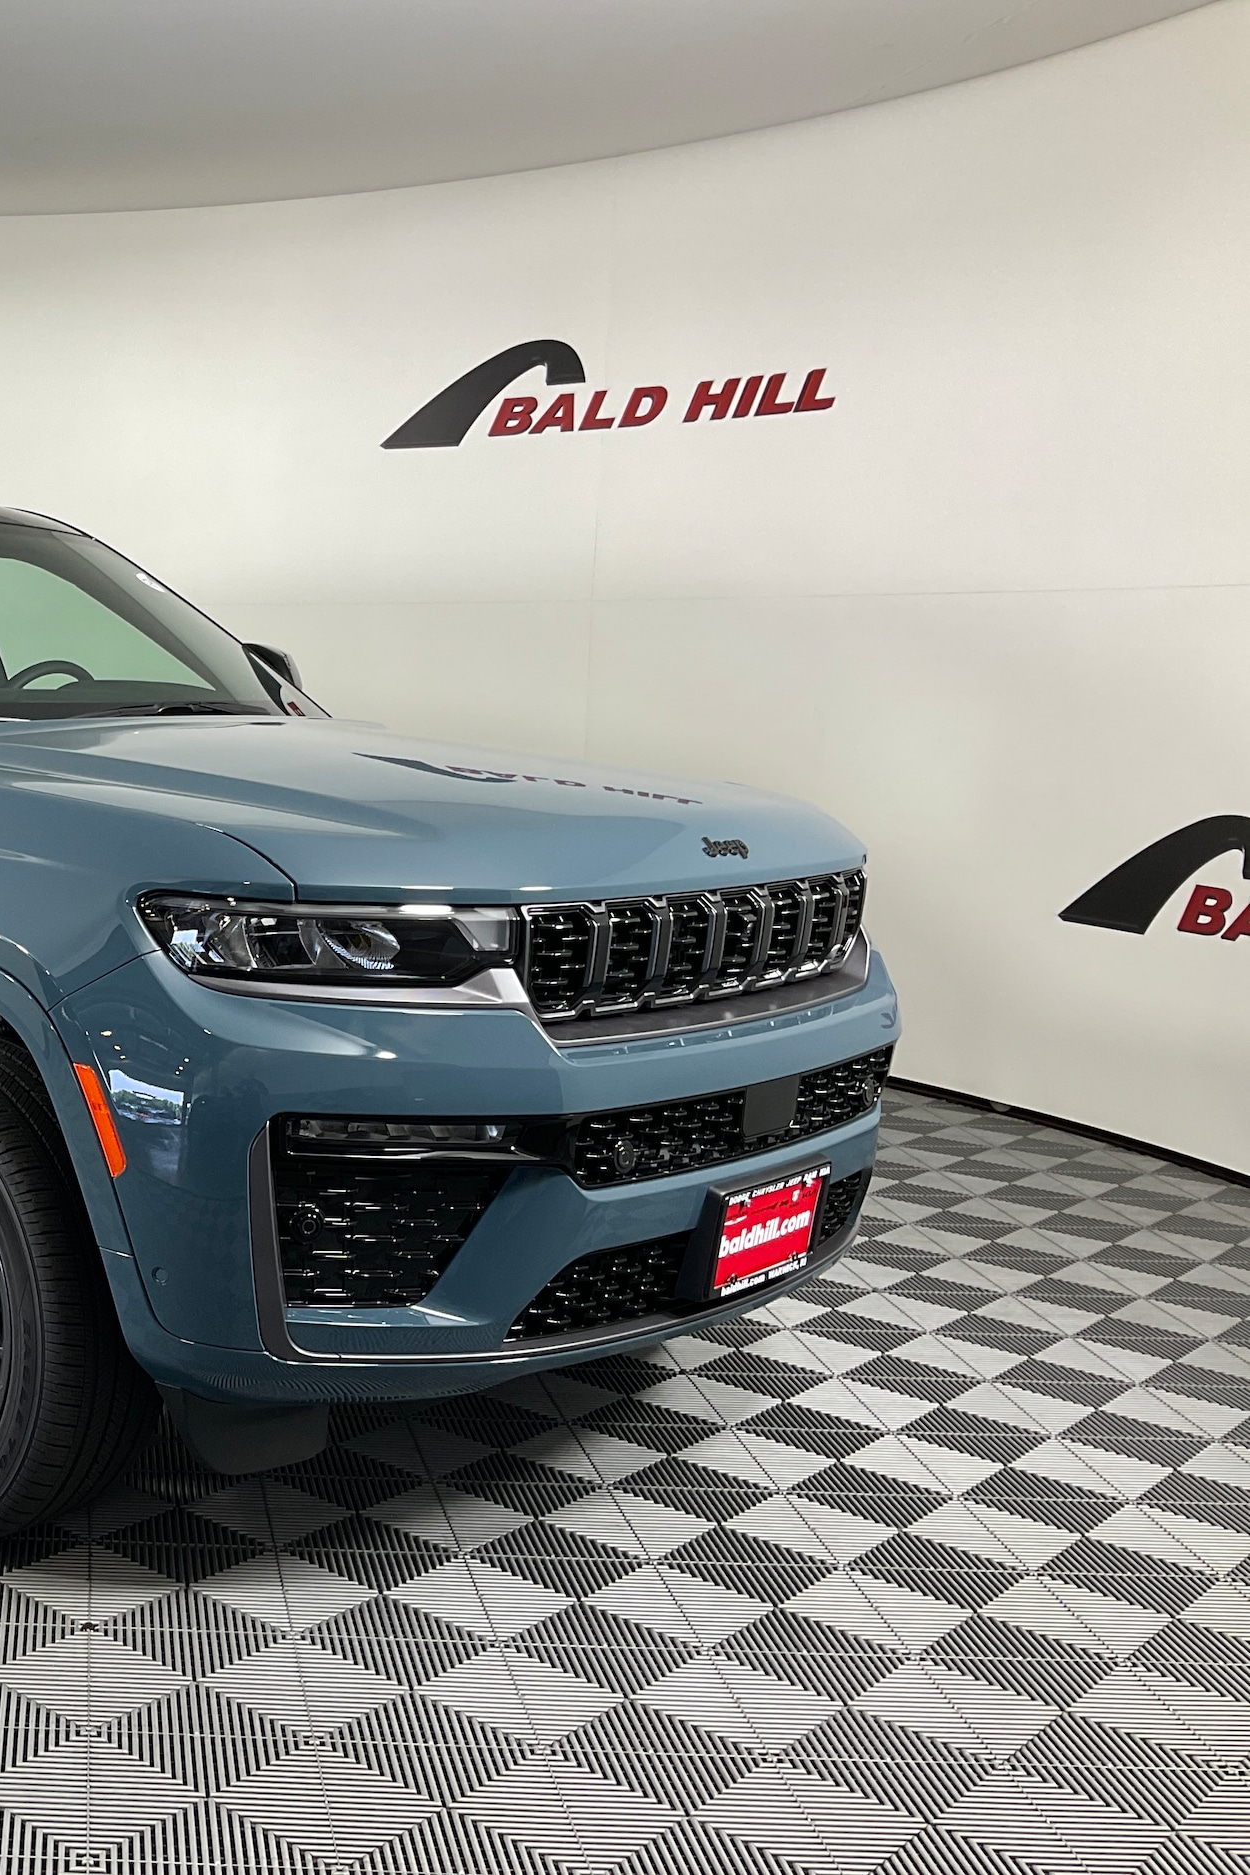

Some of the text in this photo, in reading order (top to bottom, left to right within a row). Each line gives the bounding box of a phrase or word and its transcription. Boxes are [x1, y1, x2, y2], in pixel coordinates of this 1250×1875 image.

[488, 368, 836, 437] BALD HILL
[701, 836, 749, 860] Jeep
[752, 1181, 785, 1198] CHRYSLER
[786, 1175, 803, 1188] JEEP
[718, 1210, 811, 1259] baldhill.com
[720, 1274, 766, 1297] baldhill.com
